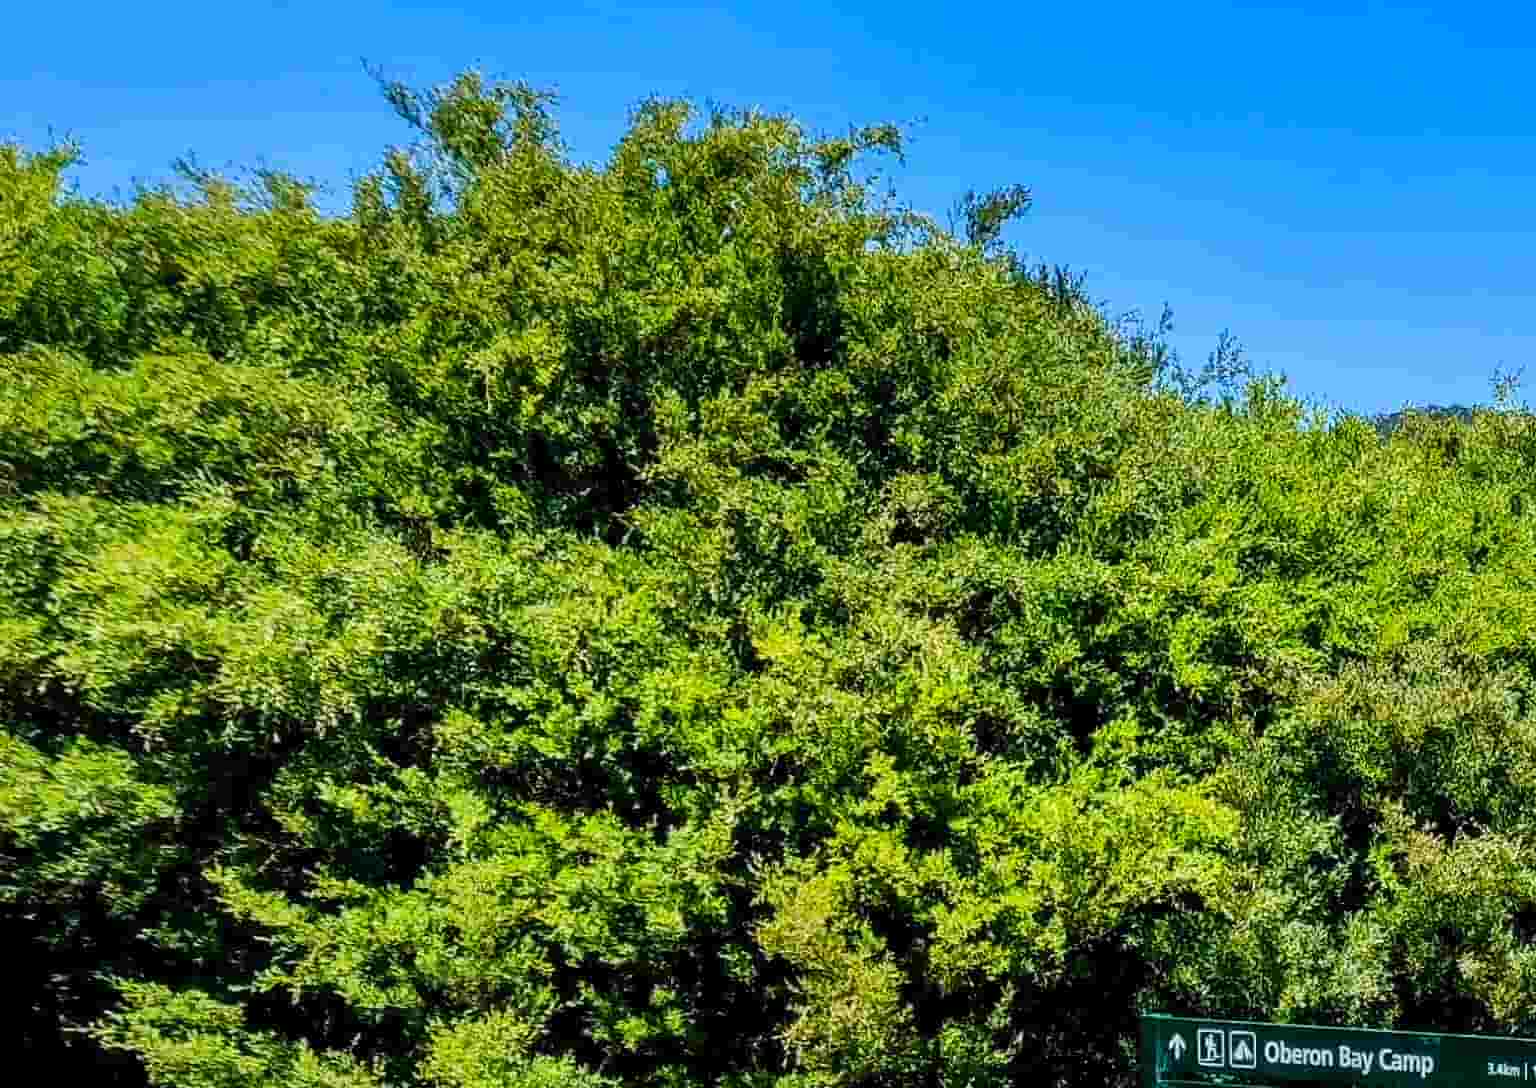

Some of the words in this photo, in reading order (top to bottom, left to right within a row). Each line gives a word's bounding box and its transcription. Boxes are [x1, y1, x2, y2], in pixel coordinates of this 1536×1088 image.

[1264, 1040, 1334, 1067] Oberon
[1338, 1045, 1375, 1075] Bay
[1379, 1049, 1435, 1079] Camp
